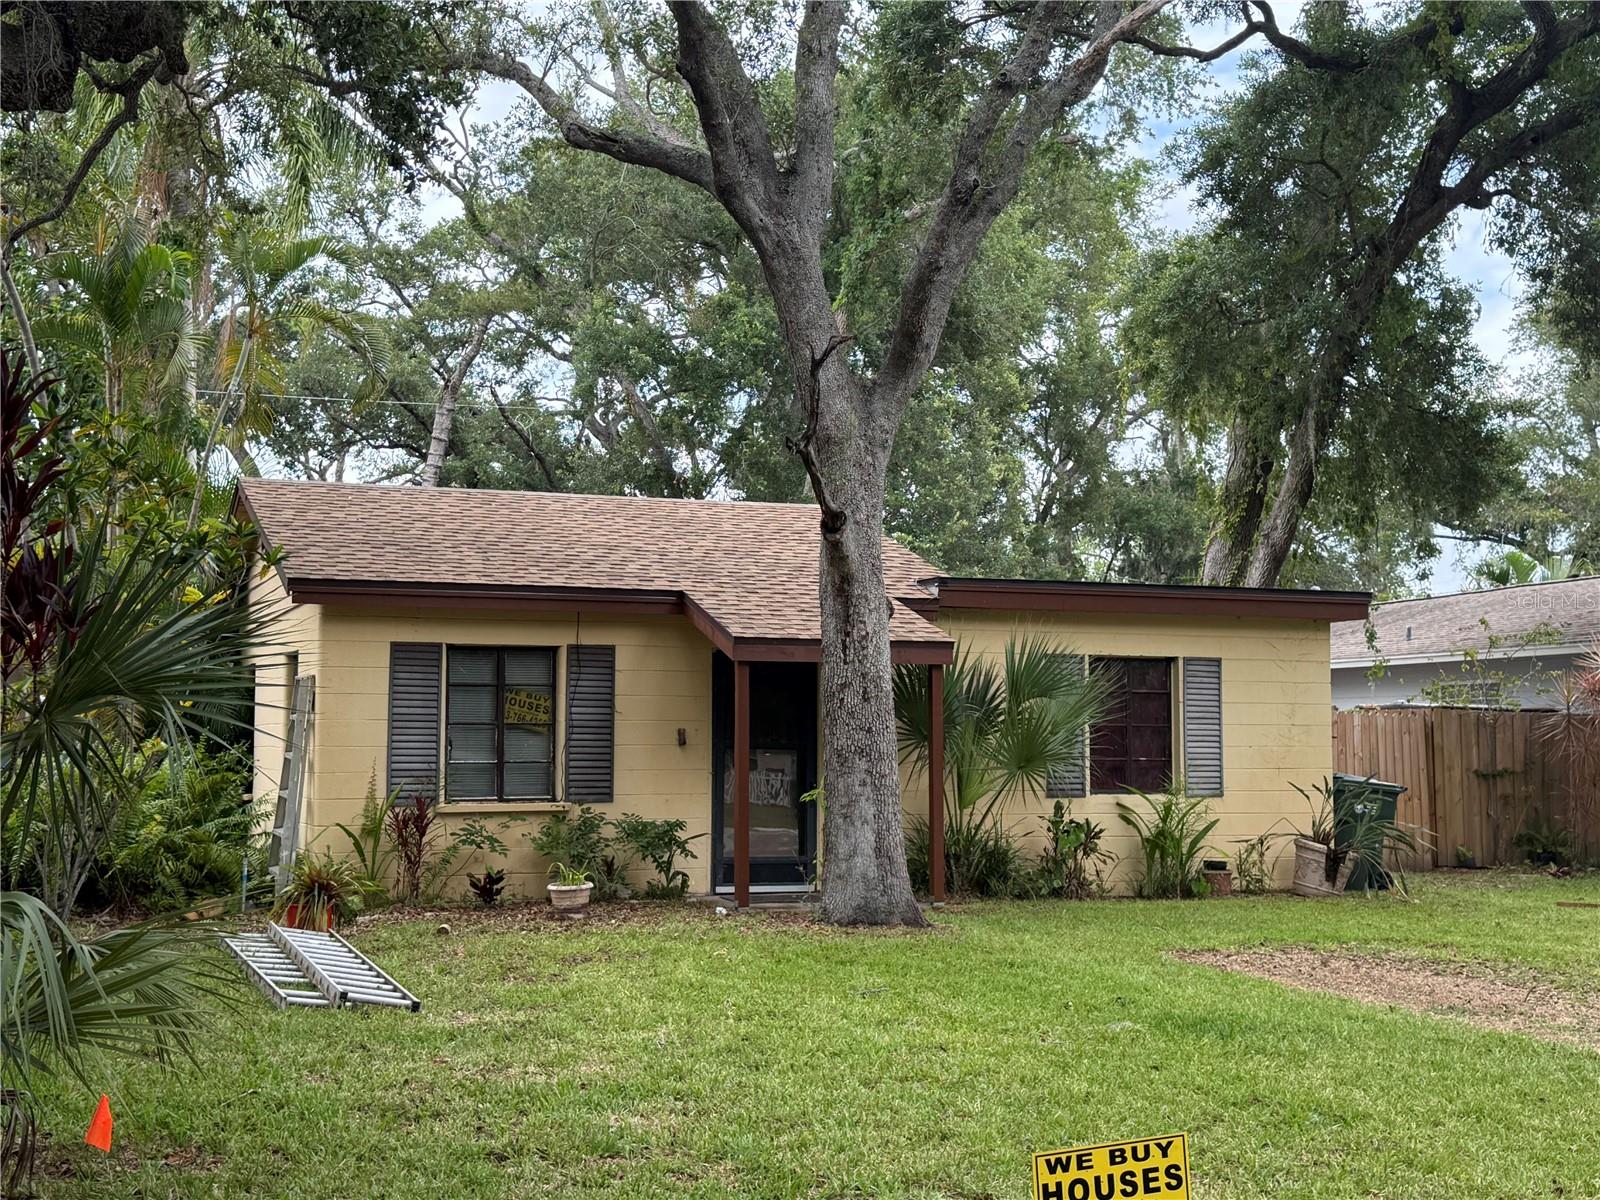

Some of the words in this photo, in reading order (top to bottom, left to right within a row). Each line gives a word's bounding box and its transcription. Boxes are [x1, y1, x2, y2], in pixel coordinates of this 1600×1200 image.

[526, 693, 551, 704] BUY
[1044, 1152, 1094, 1175] WE
[1108, 1140, 1174, 1166] BUY
[1041, 1163, 1184, 1200] HOUSES
